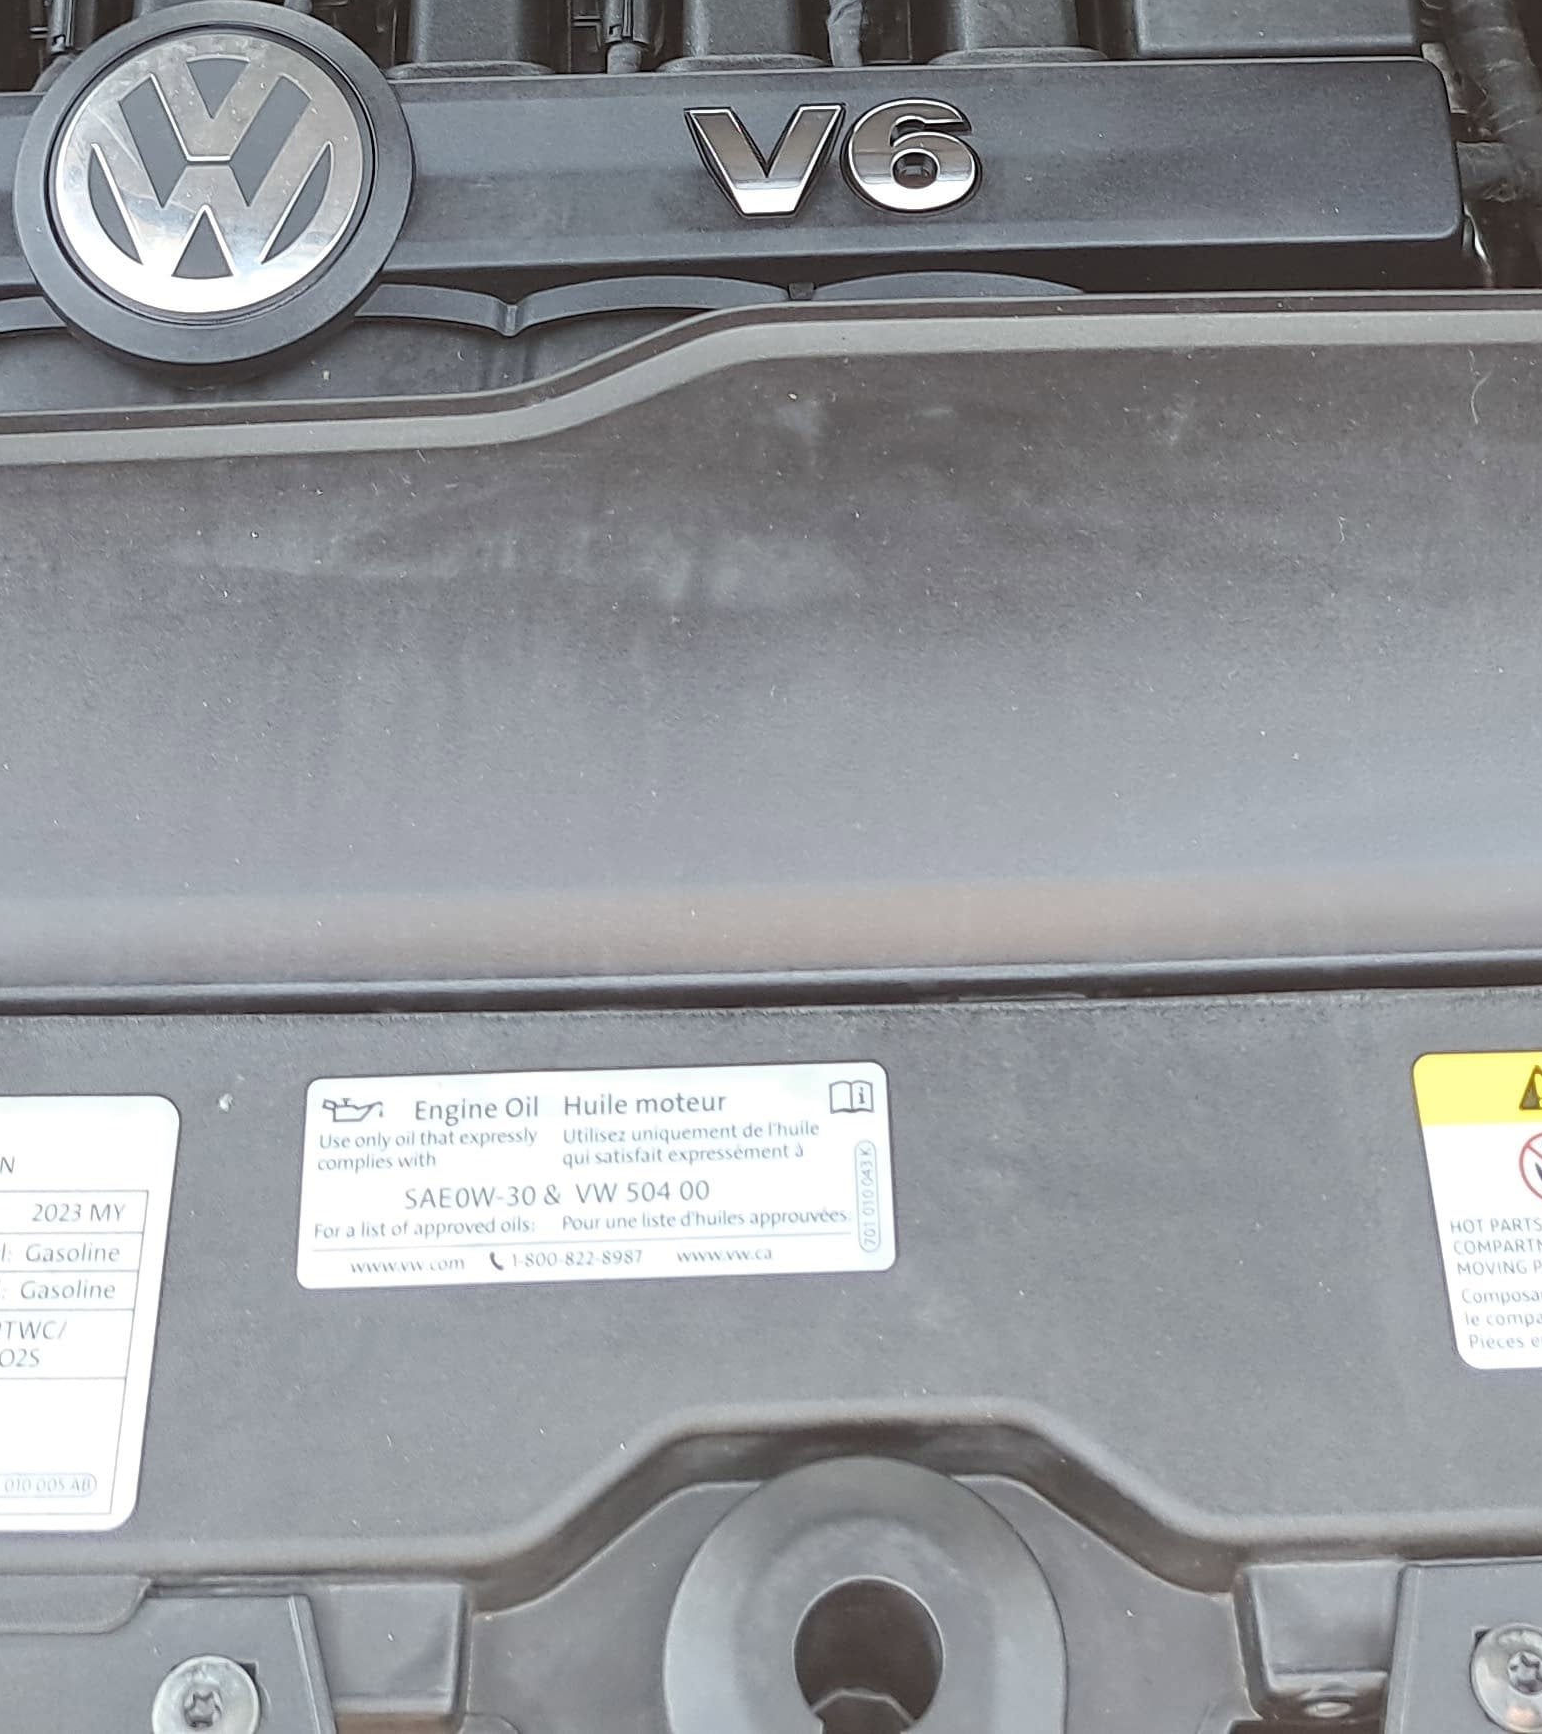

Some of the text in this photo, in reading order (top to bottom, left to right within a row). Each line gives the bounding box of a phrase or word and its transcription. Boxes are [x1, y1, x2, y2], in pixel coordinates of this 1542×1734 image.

[685, 97, 985, 220] V6
[415, 1095, 539, 1127] Engine Oil
[564, 1092, 727, 1115] Huile moteur
[319, 1127, 538, 1152] Use only oil that expressly
[563, 1119, 820, 1145] Utilisez uniquement de l'huile
[317, 1151, 437, 1174] complies with
[562, 1150, 590, 1169] qui
[594, 1147, 663, 1165] satisfait
[404, 1179, 711, 1210] SAE0W-30 & VW 504 00
[31, 1202, 128, 1223] 2023 MY
[562, 1210, 746, 1231] Pour une liste d'huiles
[314, 1215, 537, 1240] For a list of approved oils:
[1449, 1218, 1484, 1234] HOT
[24, 1243, 121, 1263] Gasoline
[676, 1248, 773, 1264] www.vw.ca
[1457, 1259, 1529, 1277] MOVING
[19, 1279, 117, 1300] Gasoline
[1465, 1311, 1480, 1327] le
